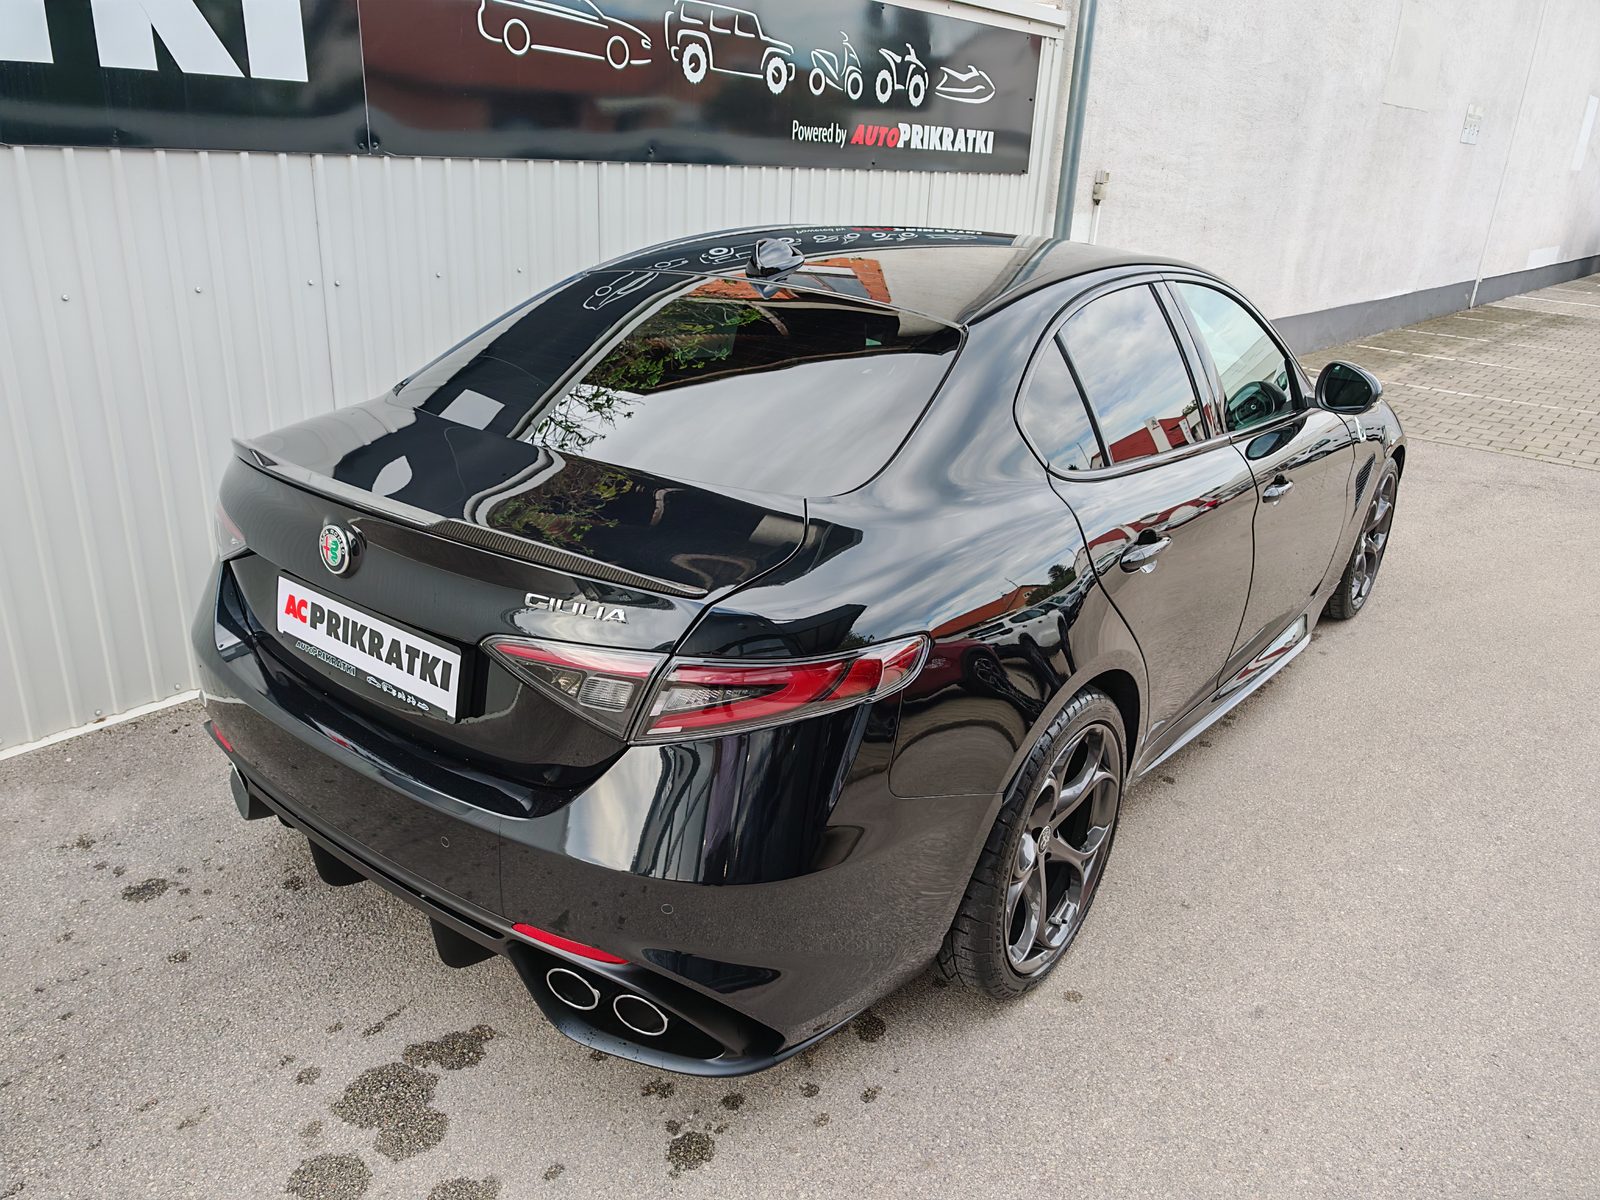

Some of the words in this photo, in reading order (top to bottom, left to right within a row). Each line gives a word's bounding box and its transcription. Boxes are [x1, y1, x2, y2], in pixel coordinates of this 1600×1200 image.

[792, 119, 834, 143] Powered
[835, 122, 847, 149] by
[850, 122, 995, 154] AUTOPRIKRATKI
[525, 592, 628, 624] GIULIA
